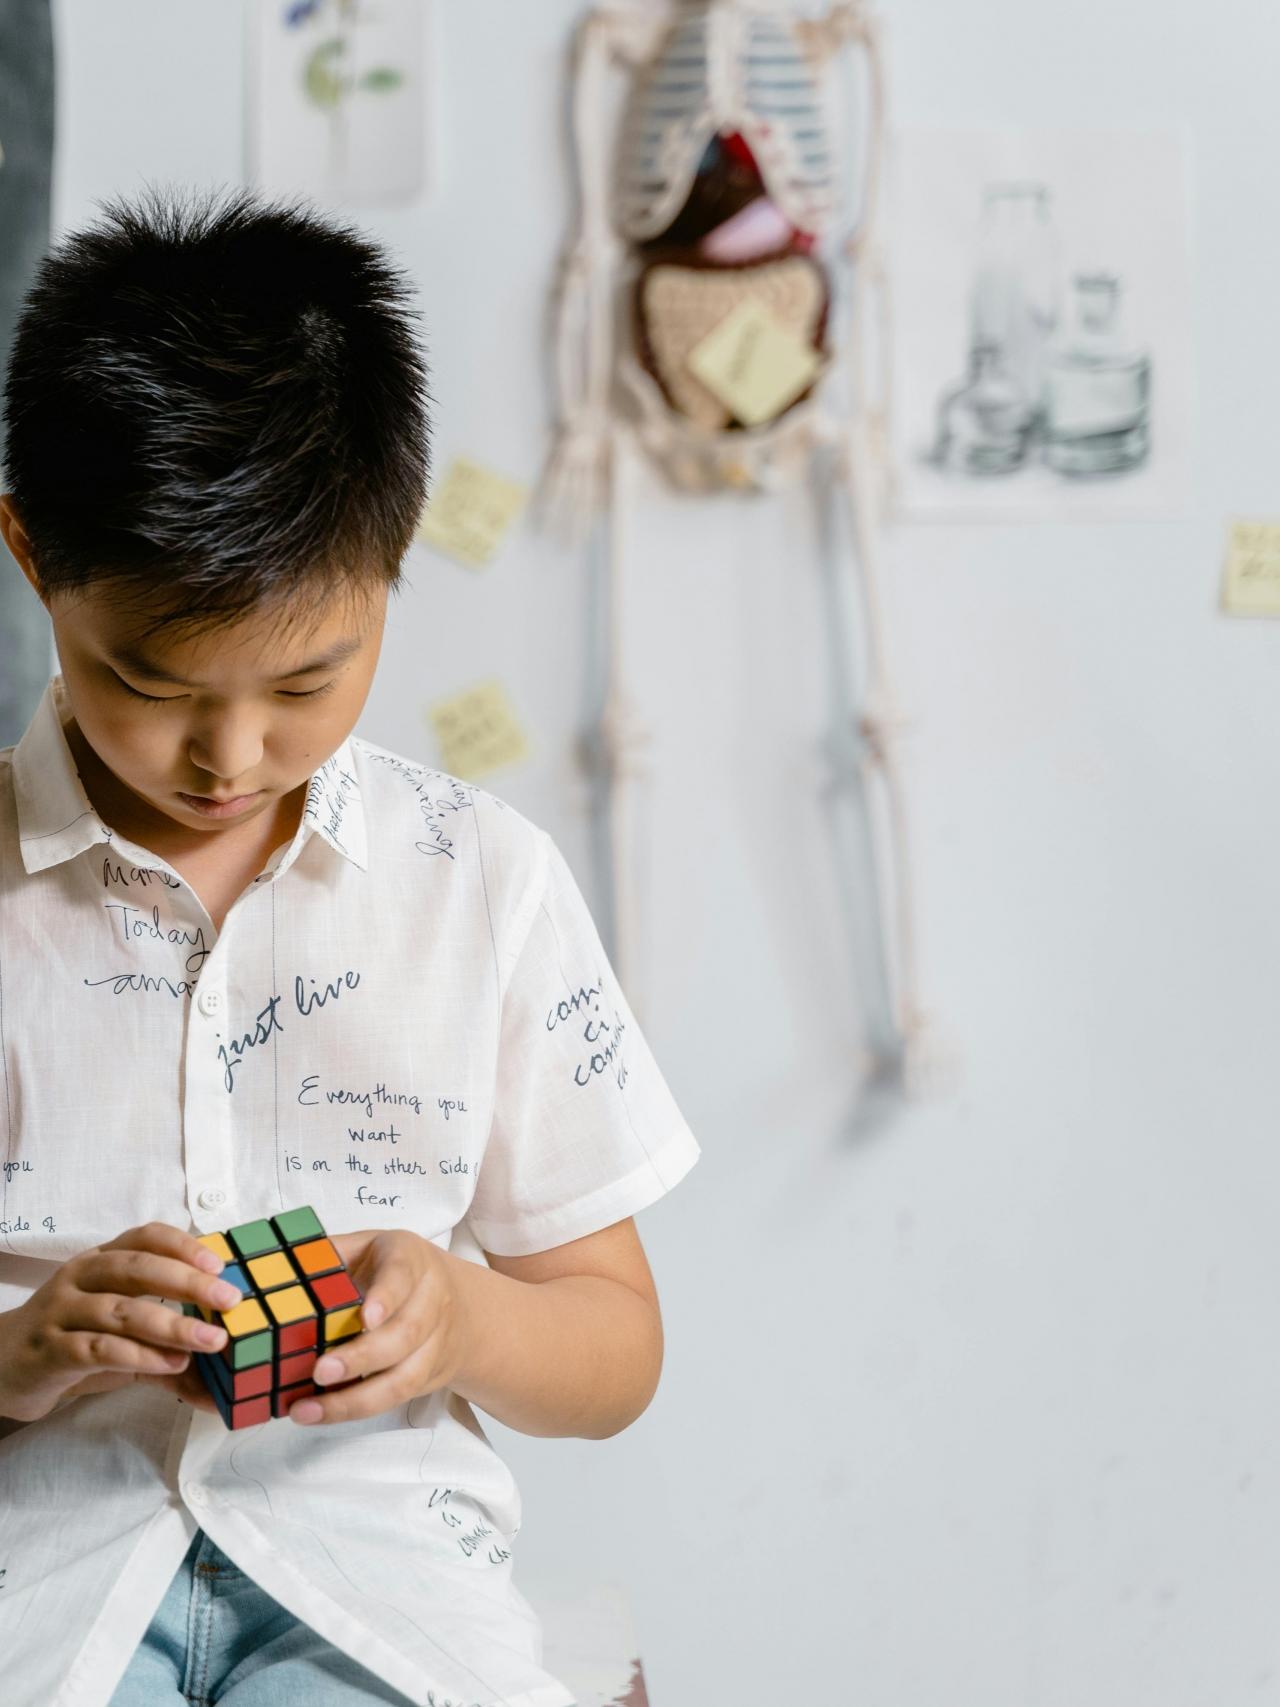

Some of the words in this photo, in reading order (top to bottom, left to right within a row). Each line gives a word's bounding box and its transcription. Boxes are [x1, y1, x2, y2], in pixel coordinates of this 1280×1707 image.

[104, 905, 211, 973] Today
[216, 995, 284, 1093] just
[295, 970, 361, 1016] live
[297, 1075, 423, 1118] Everything
[438, 1095, 469, 1120] you
[3, 1160, 34, 1182] you
[312, 1159, 332, 1172] on
[345, 1153, 372, 1175] the
[384, 1156, 427, 1175] other
[42, 1216, 56, 1233] of
